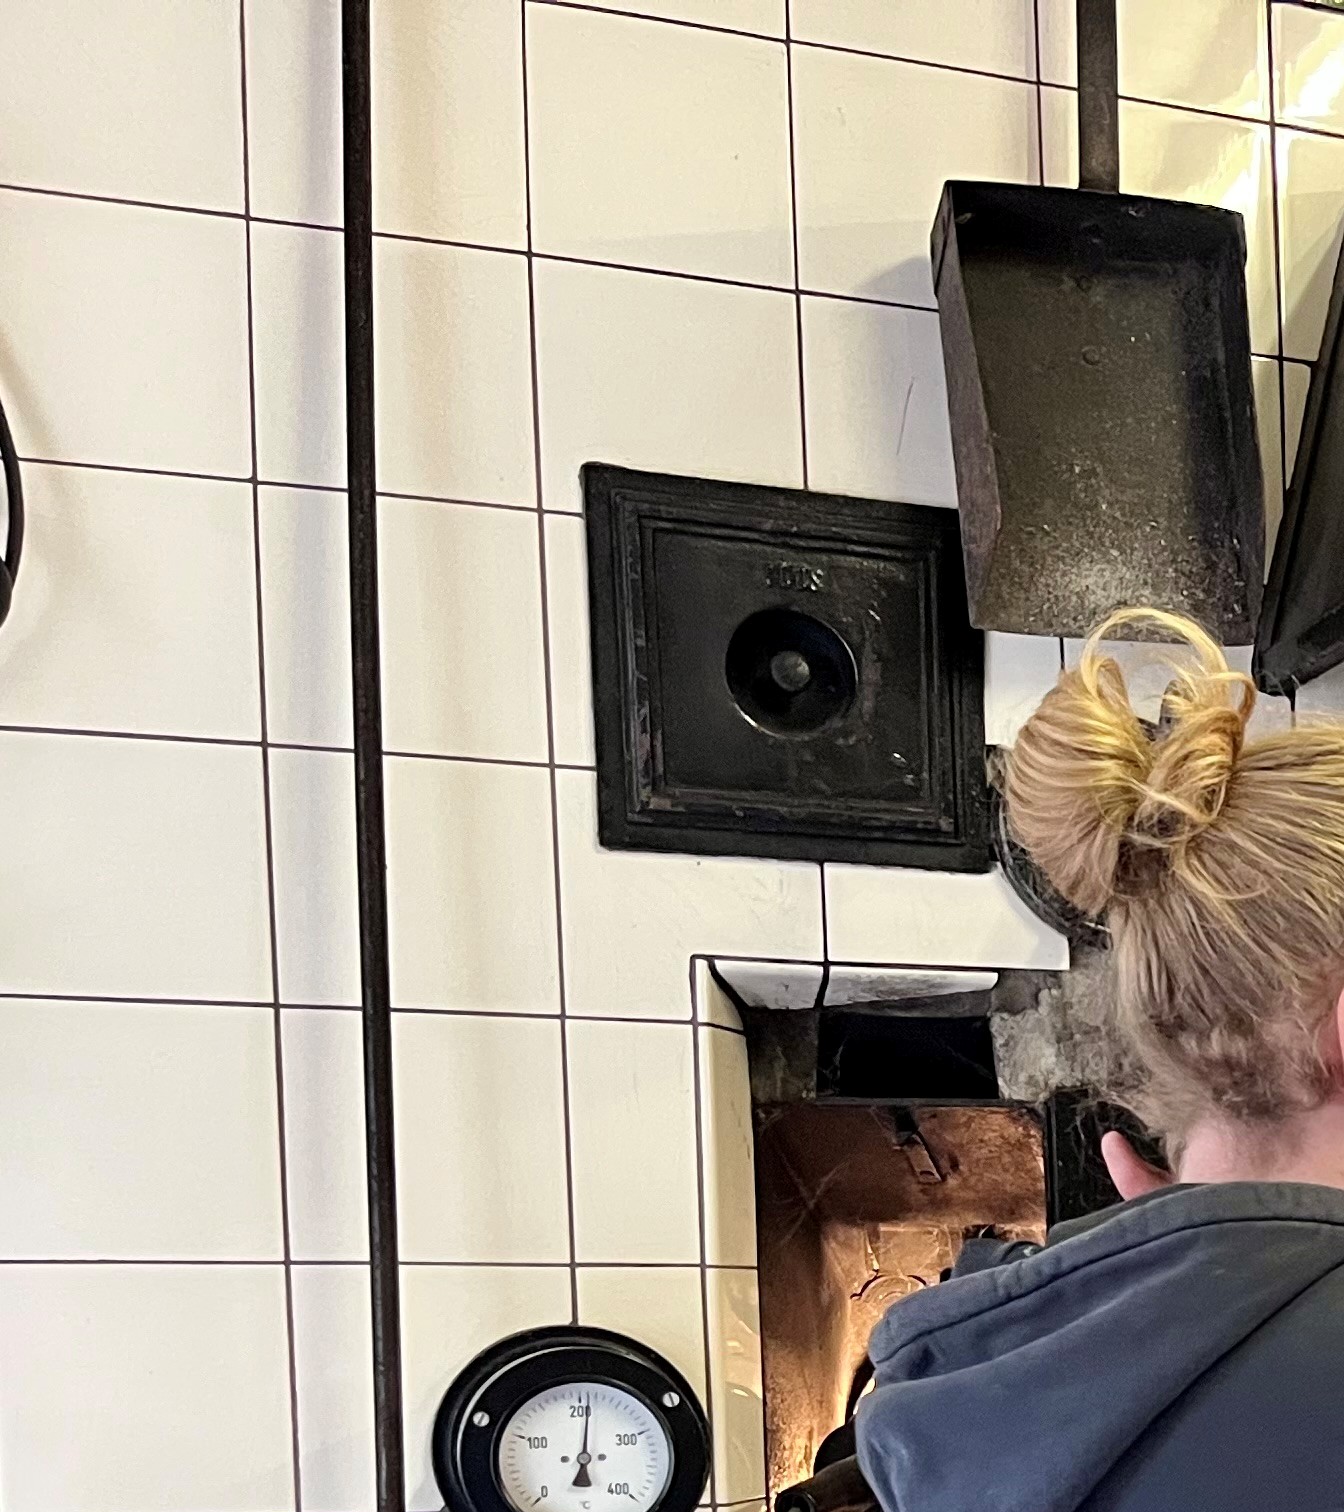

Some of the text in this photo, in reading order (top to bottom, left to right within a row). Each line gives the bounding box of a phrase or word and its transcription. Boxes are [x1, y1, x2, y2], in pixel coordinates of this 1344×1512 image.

[570, 1405, 592, 1417] 200
[527, 1437, 548, 1449] 100
[615, 1434, 637, 1445] 300
[541, 1486, 548, 1497] 0
[608, 1483, 630, 1495] 400
